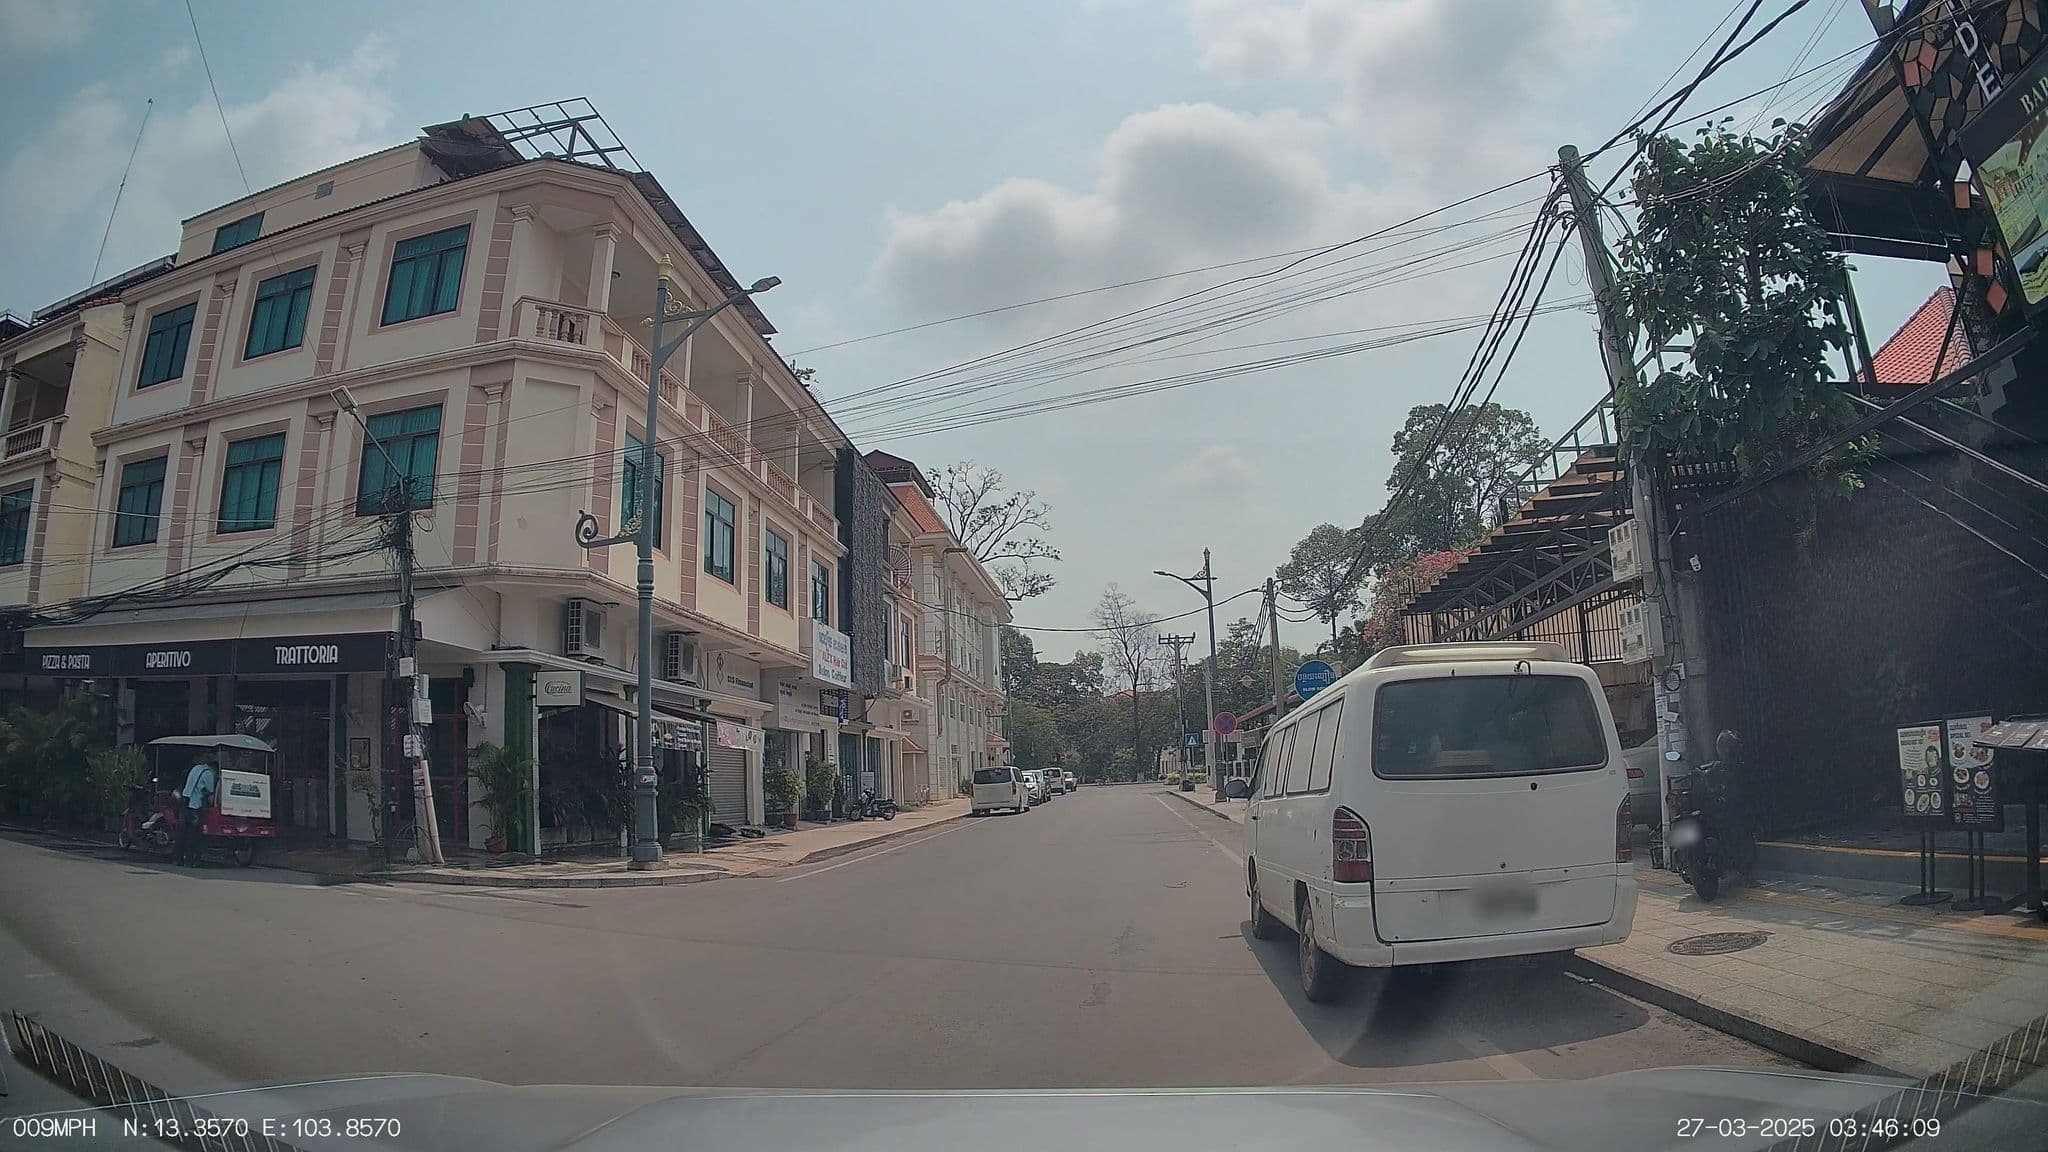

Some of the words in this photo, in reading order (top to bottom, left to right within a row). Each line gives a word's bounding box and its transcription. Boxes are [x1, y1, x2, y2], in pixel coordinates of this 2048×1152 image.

[1947, 0, 2002, 102] DE
[42, 654, 60, 669] PIZZA
[61, 655, 67, 669] &
[68, 654, 90, 669] PASTA
[145, 651, 191, 668] APERITIVO
[275, 645, 338, 664] TRATTORIA
